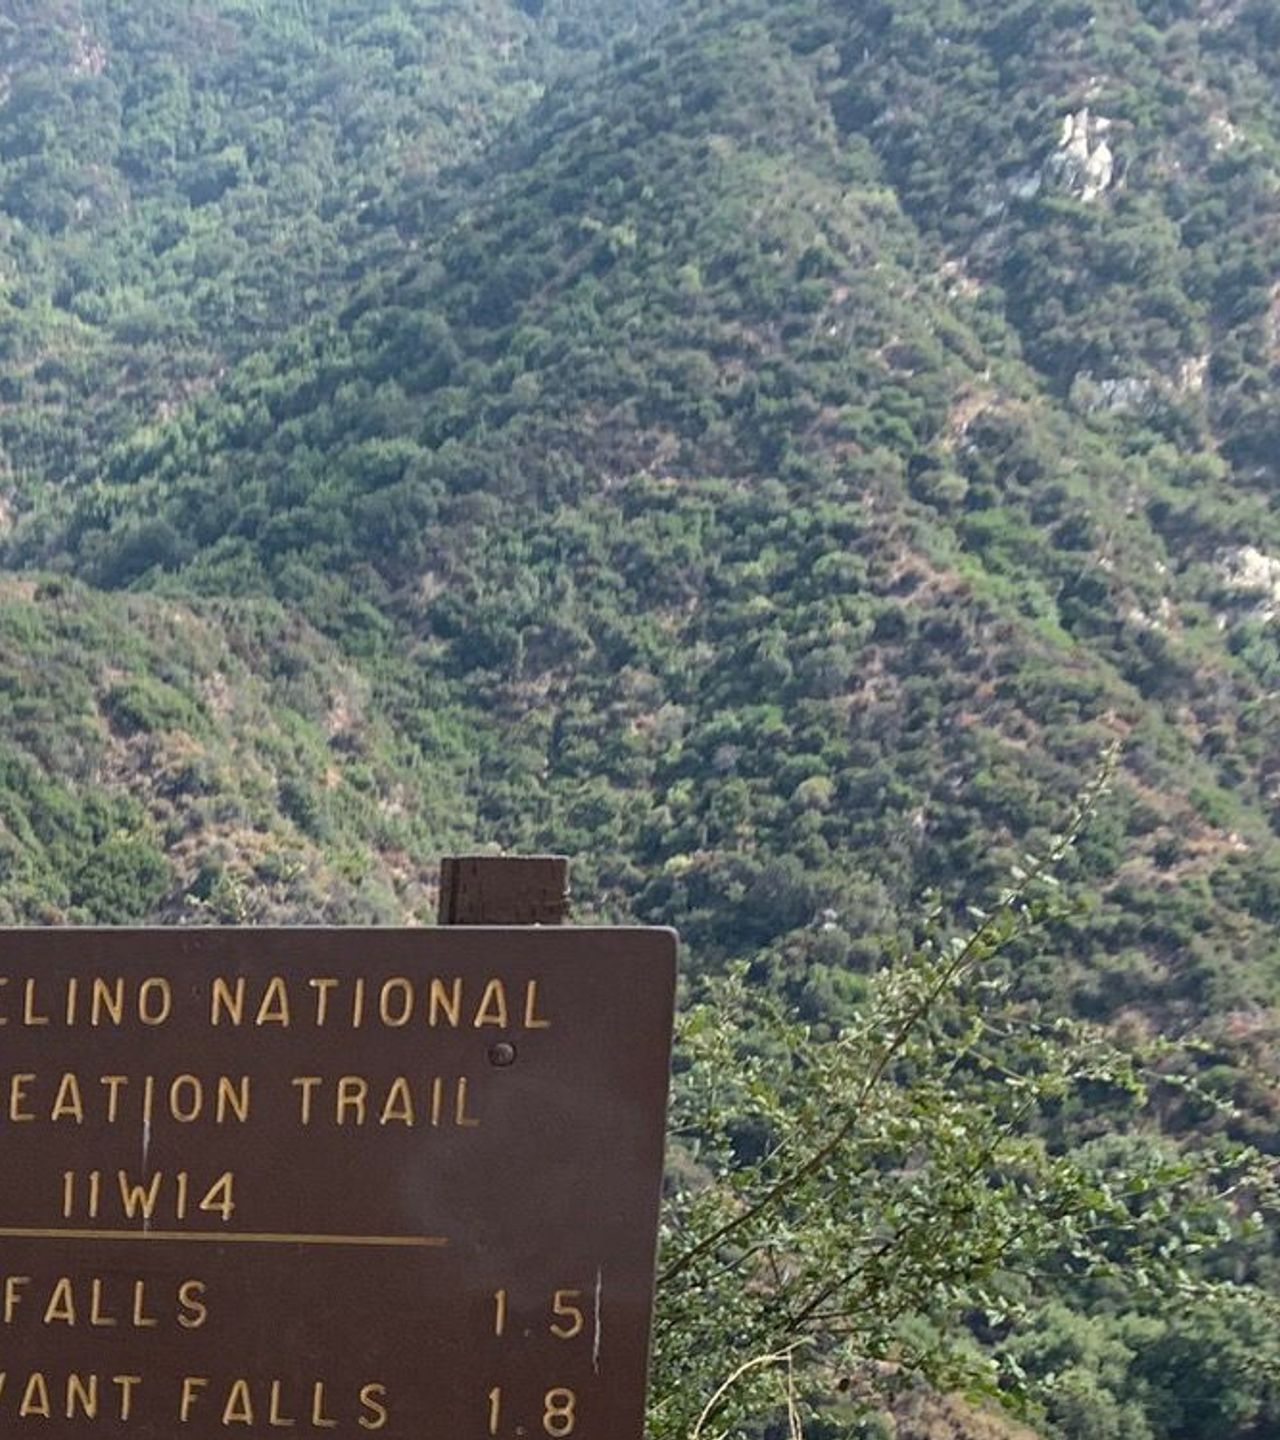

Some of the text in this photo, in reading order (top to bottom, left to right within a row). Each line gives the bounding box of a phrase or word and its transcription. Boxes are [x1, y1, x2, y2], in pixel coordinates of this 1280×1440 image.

[211, 976, 551, 1029] NATIONAL
[291, 1075, 478, 1127] TRAIL
[63, 1169, 236, 1220] 11W14
[3, 1276, 207, 1328] FALLS
[180, 1376, 387, 1430] FALLS
